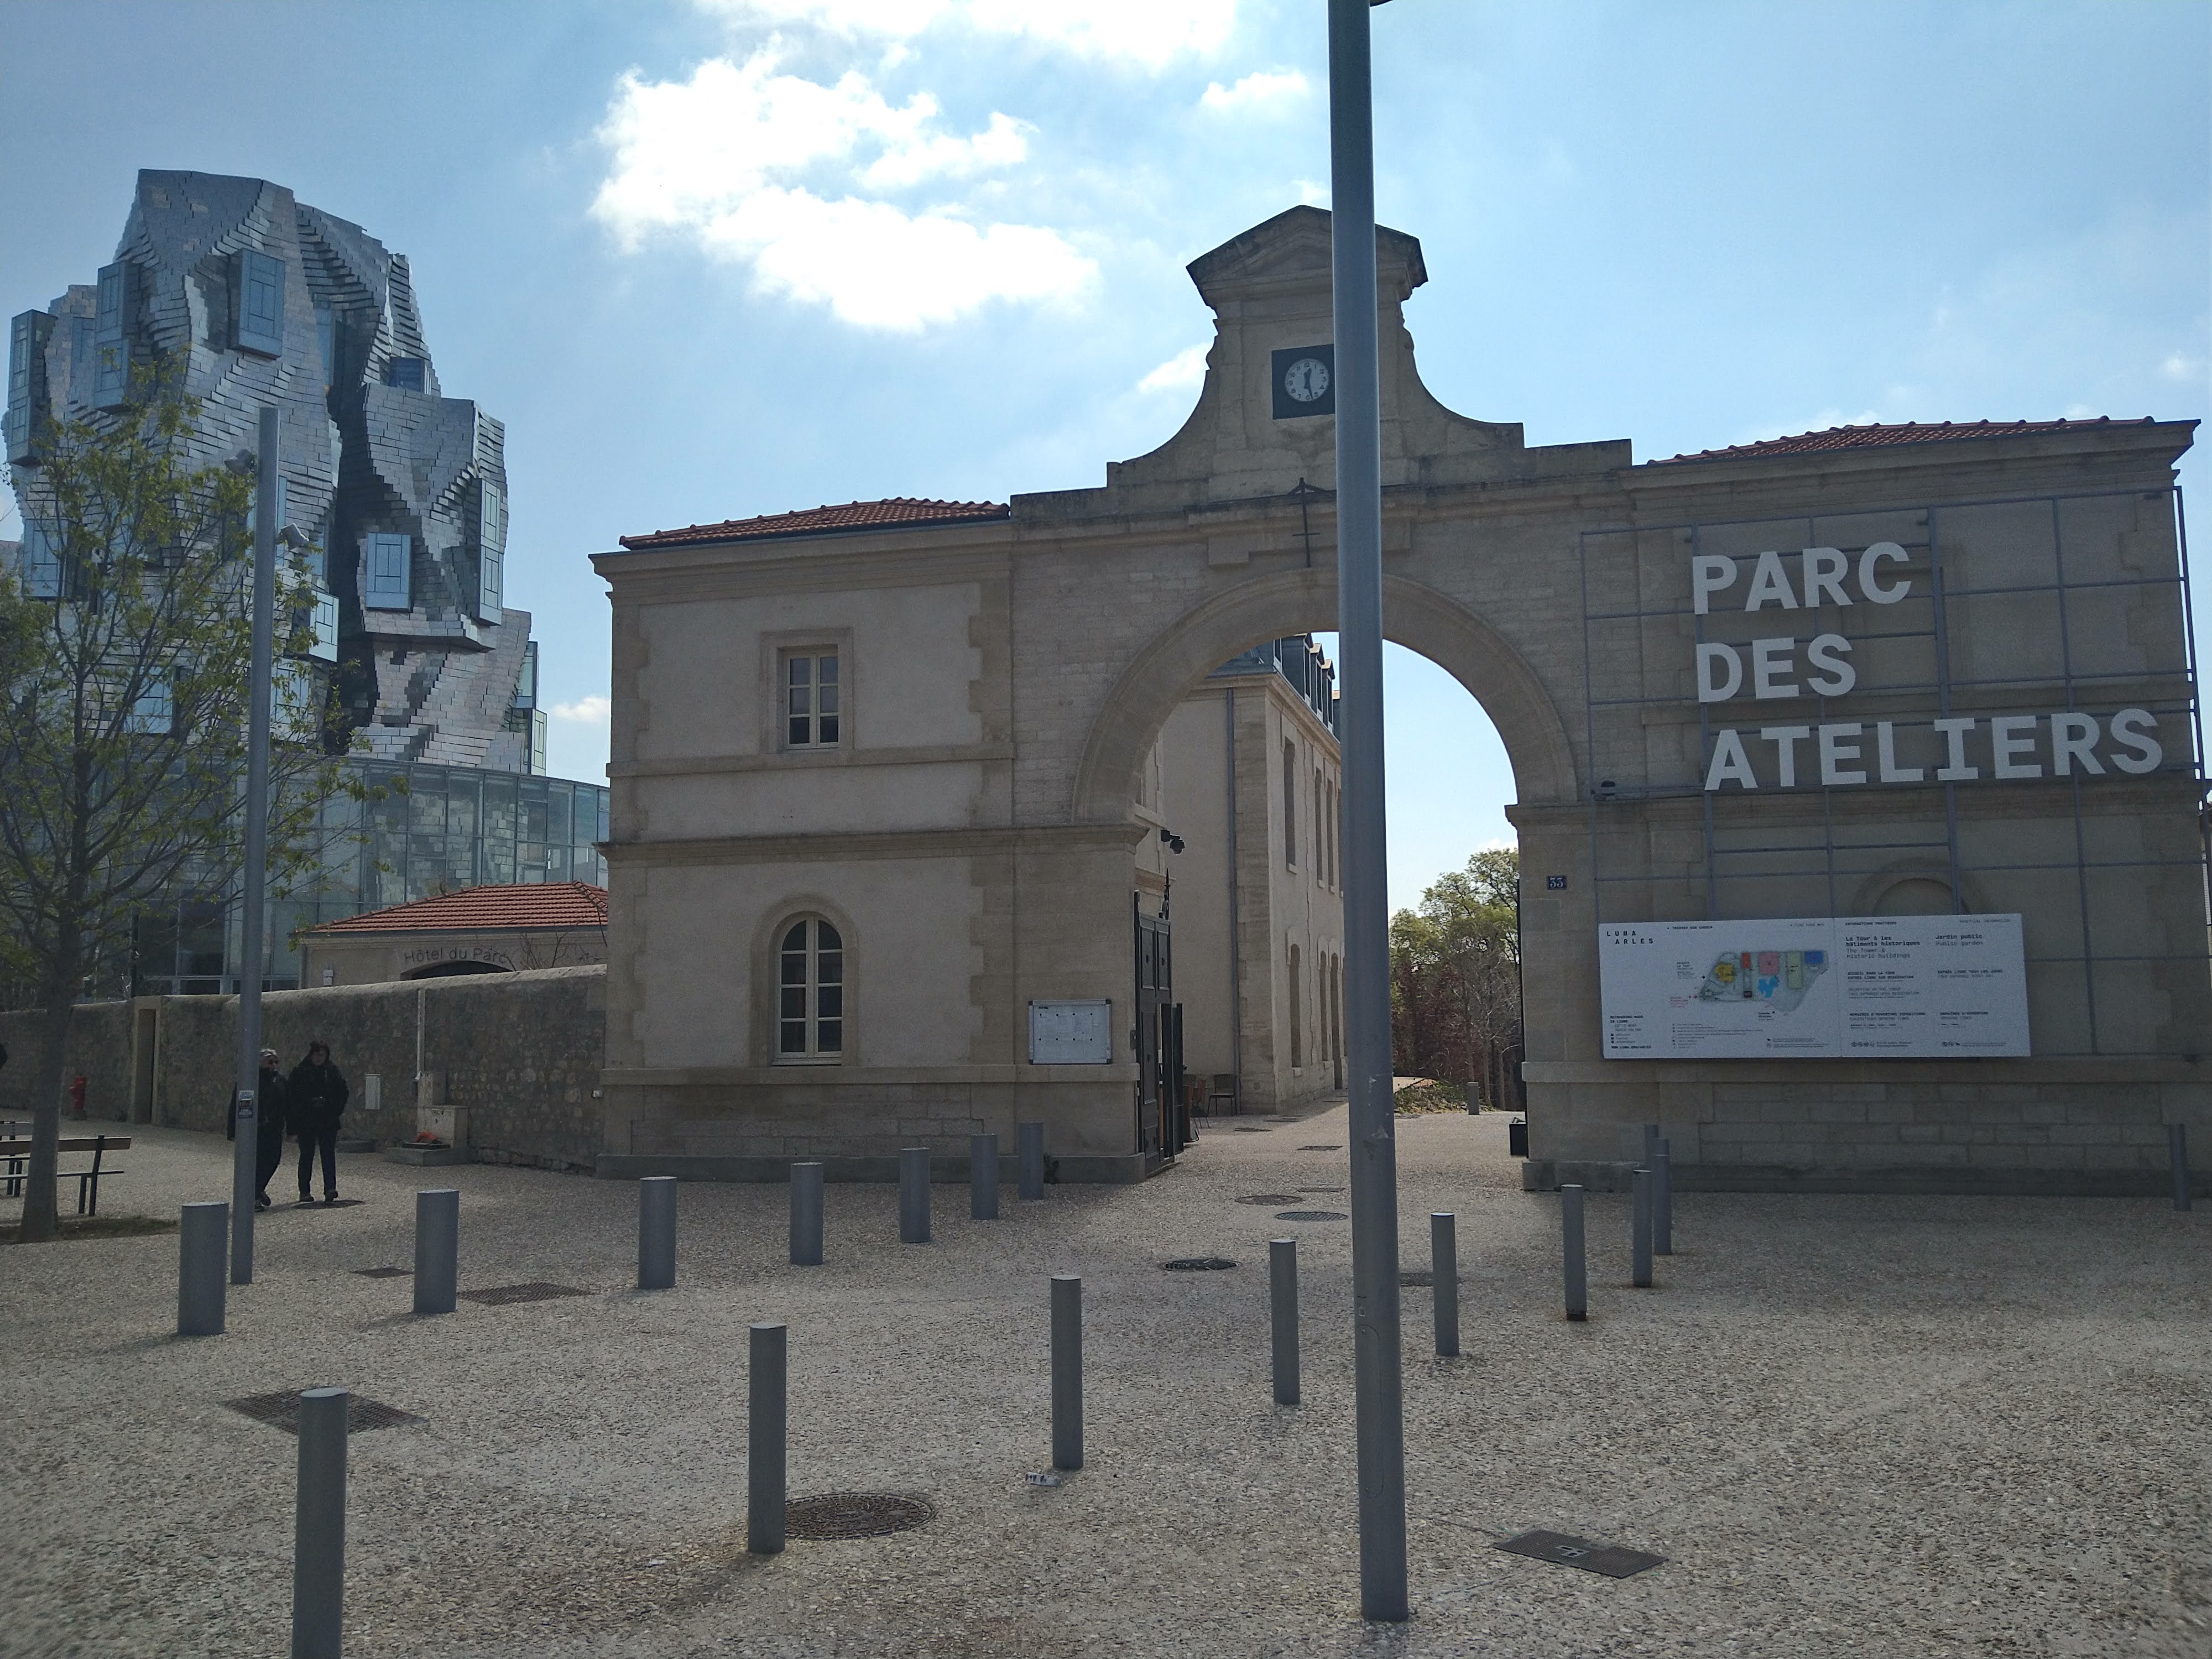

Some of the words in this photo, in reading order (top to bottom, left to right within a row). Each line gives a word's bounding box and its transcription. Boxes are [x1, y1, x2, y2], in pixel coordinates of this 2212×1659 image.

[1692, 542, 1912, 615] PARC
[1695, 633, 1856, 703] DES
[1704, 708, 2163, 791] ATELIERS
[1550, 877, 1564, 888] 33
[404, 947, 442, 963] Hôtel
[449, 947, 467, 960] du
[473, 947, 507, 964] Parc
